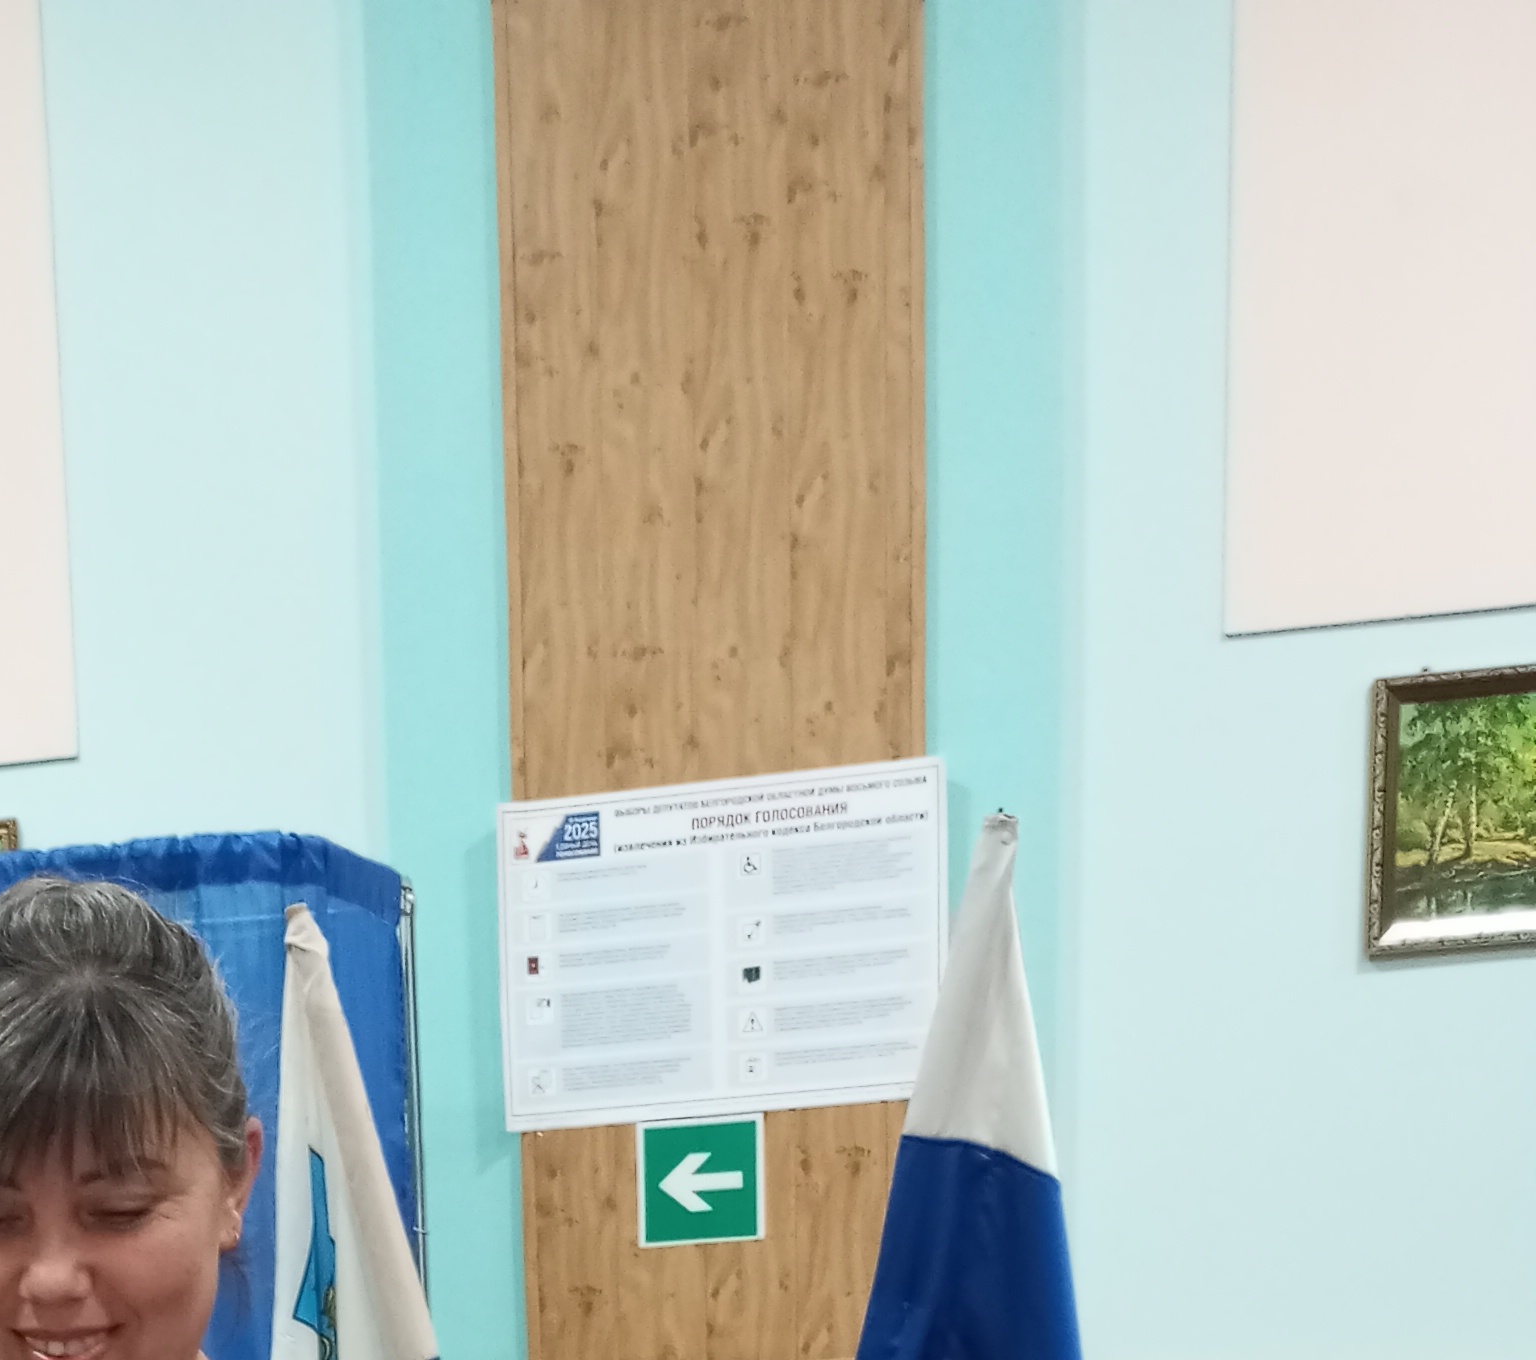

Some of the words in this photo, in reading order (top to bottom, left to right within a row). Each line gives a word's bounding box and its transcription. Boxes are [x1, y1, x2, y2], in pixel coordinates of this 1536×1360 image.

[691, 813, 751, 830] ПОРЯДОК
[755, 801, 849, 823] ГОЛОСОВАНИЯ
[564, 821, 599, 841] 2025
